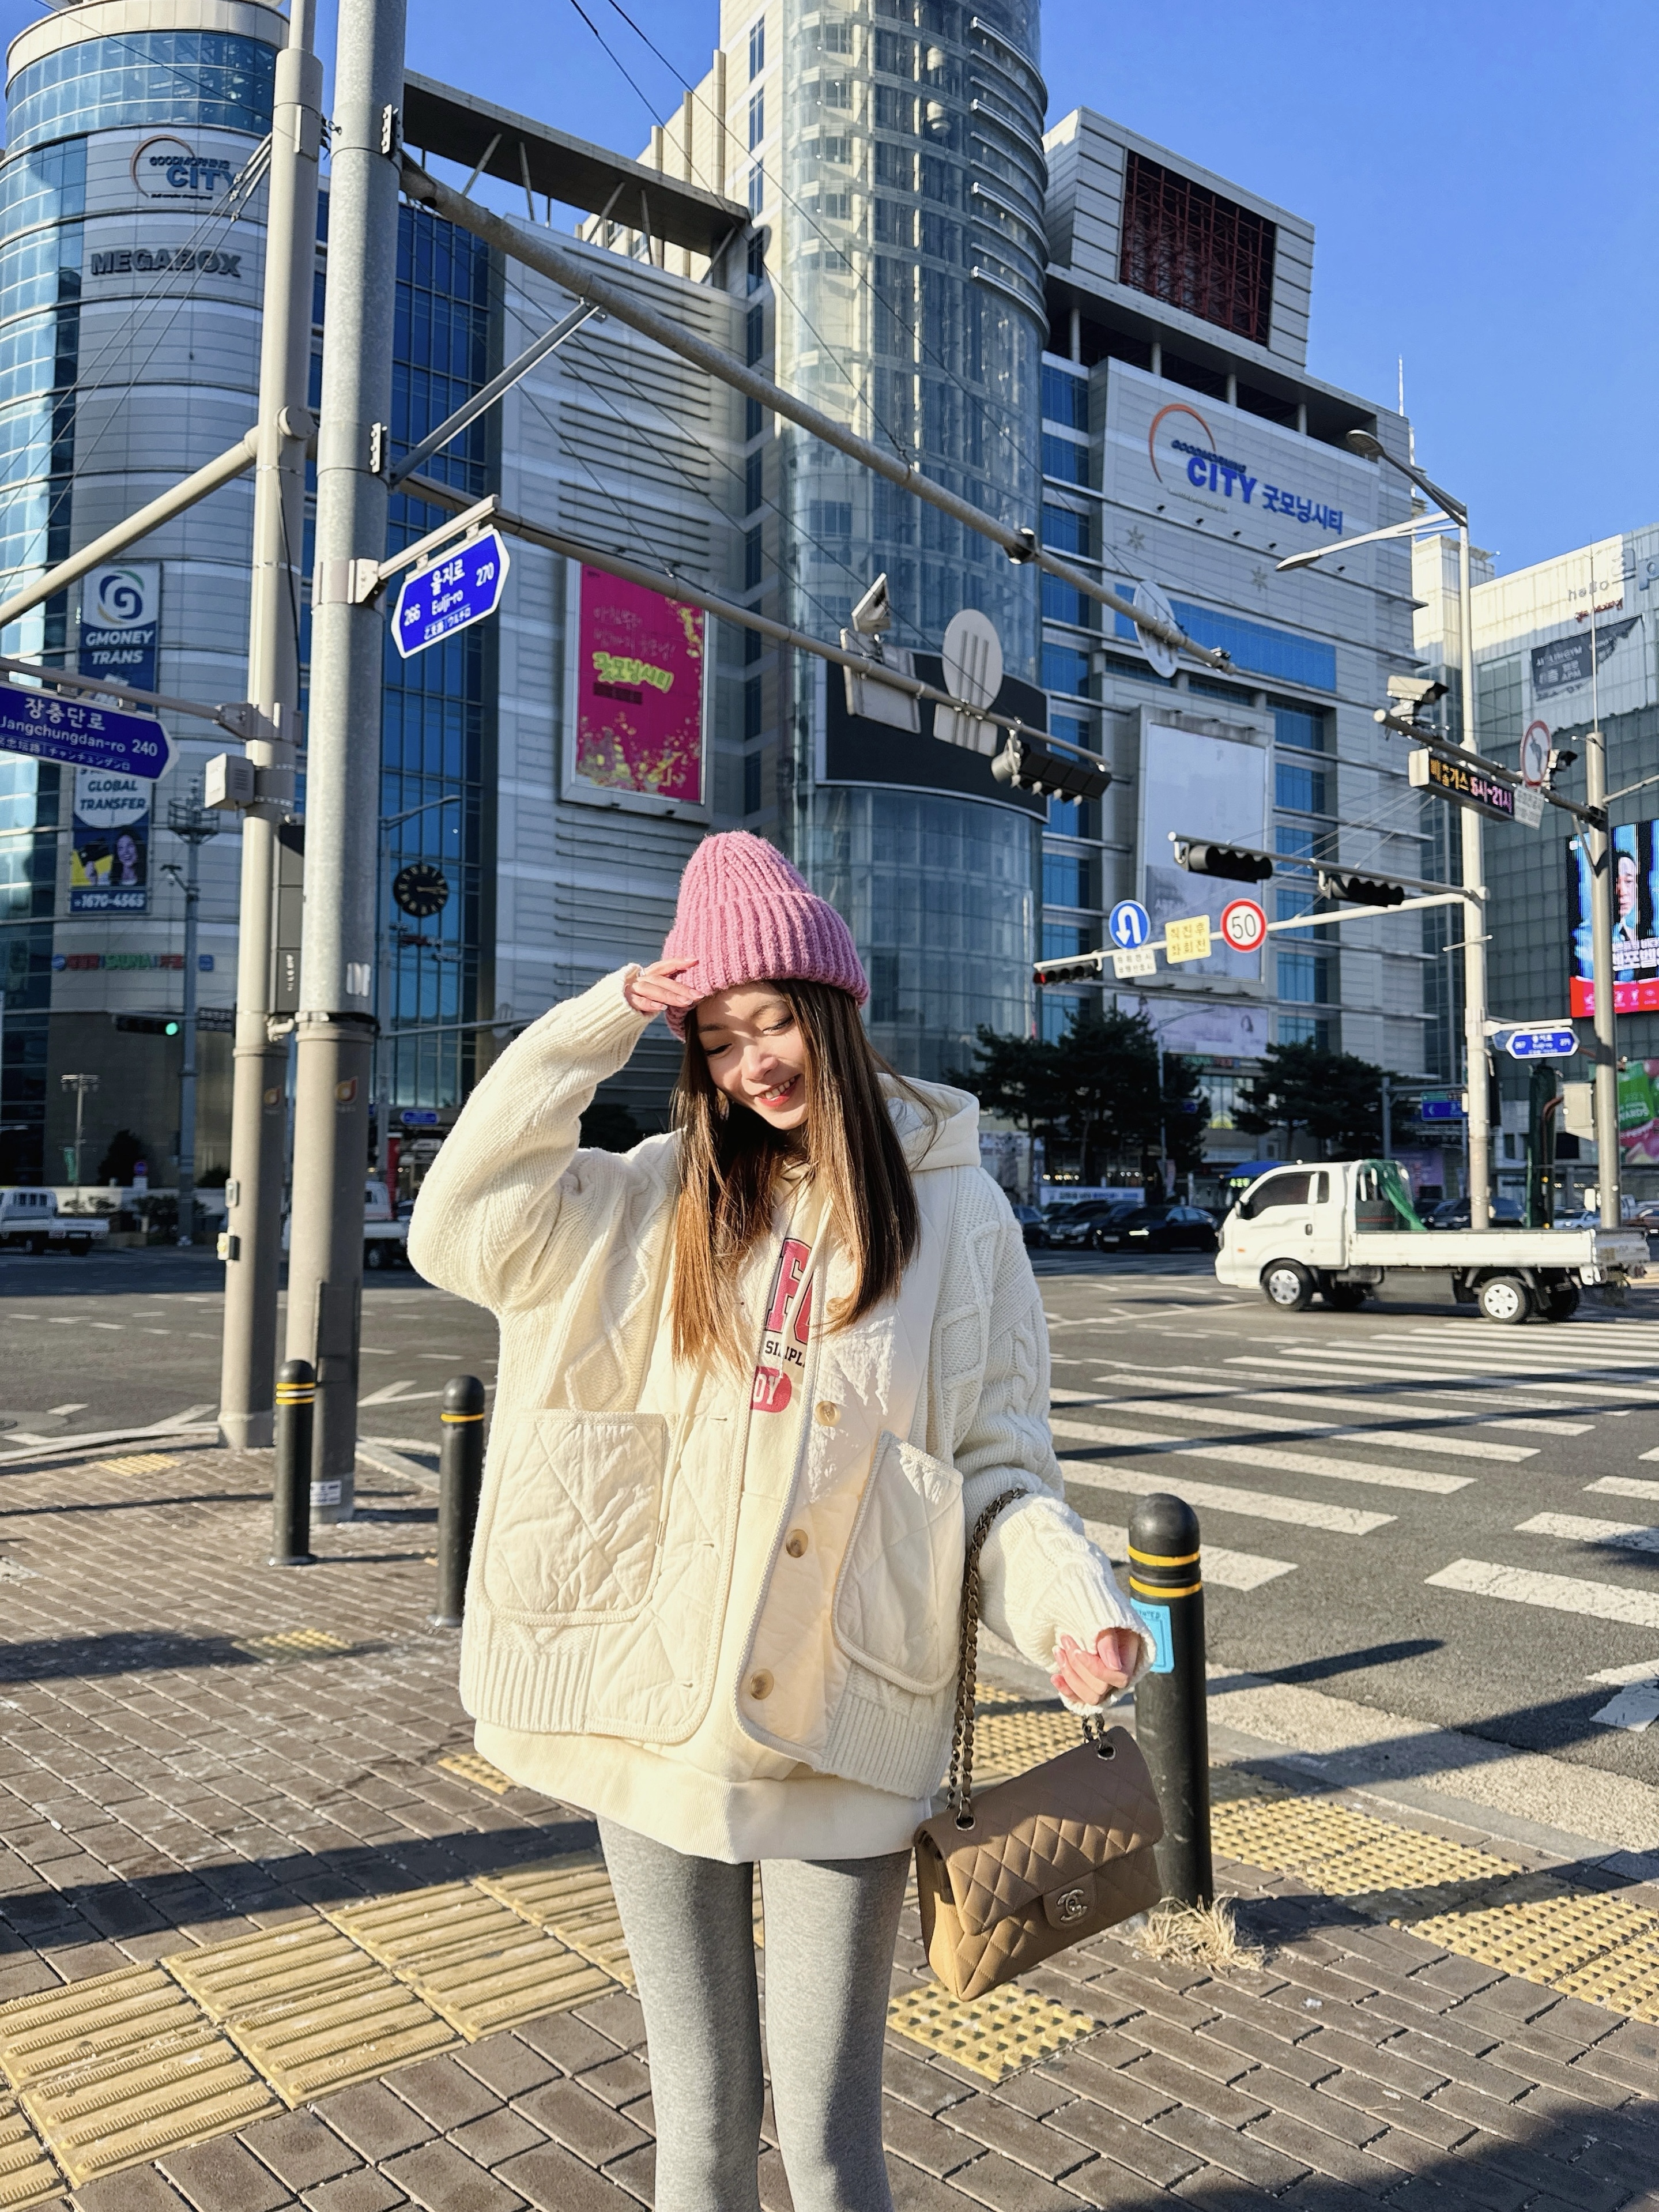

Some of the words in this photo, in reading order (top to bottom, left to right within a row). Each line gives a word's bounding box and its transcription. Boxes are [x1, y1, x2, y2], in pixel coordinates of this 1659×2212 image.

[91, 248, 242, 278] MEGABOX
[1187, 456, 1257, 504] CITY
[1262, 484, 1344, 536] 굿모닝시티
[430, 559, 466, 596] 을지로
[476, 562, 495, 587] 270
[85, 630, 154, 646] GMONEY
[92, 649, 144, 665] TRANS
[593, 652, 673, 692] 굿모닝시티
[24, 696, 106, 731] 장충단로
[0, 715, 126, 753] Jangchungdan-ro
[131, 738, 159, 758] 240
[88, 779, 138, 792] GLOBAL
[80, 797, 146, 811] TRANSFER
[1231, 914, 1257, 940] 50
[765, 1340, 805, 1368] SIPL
